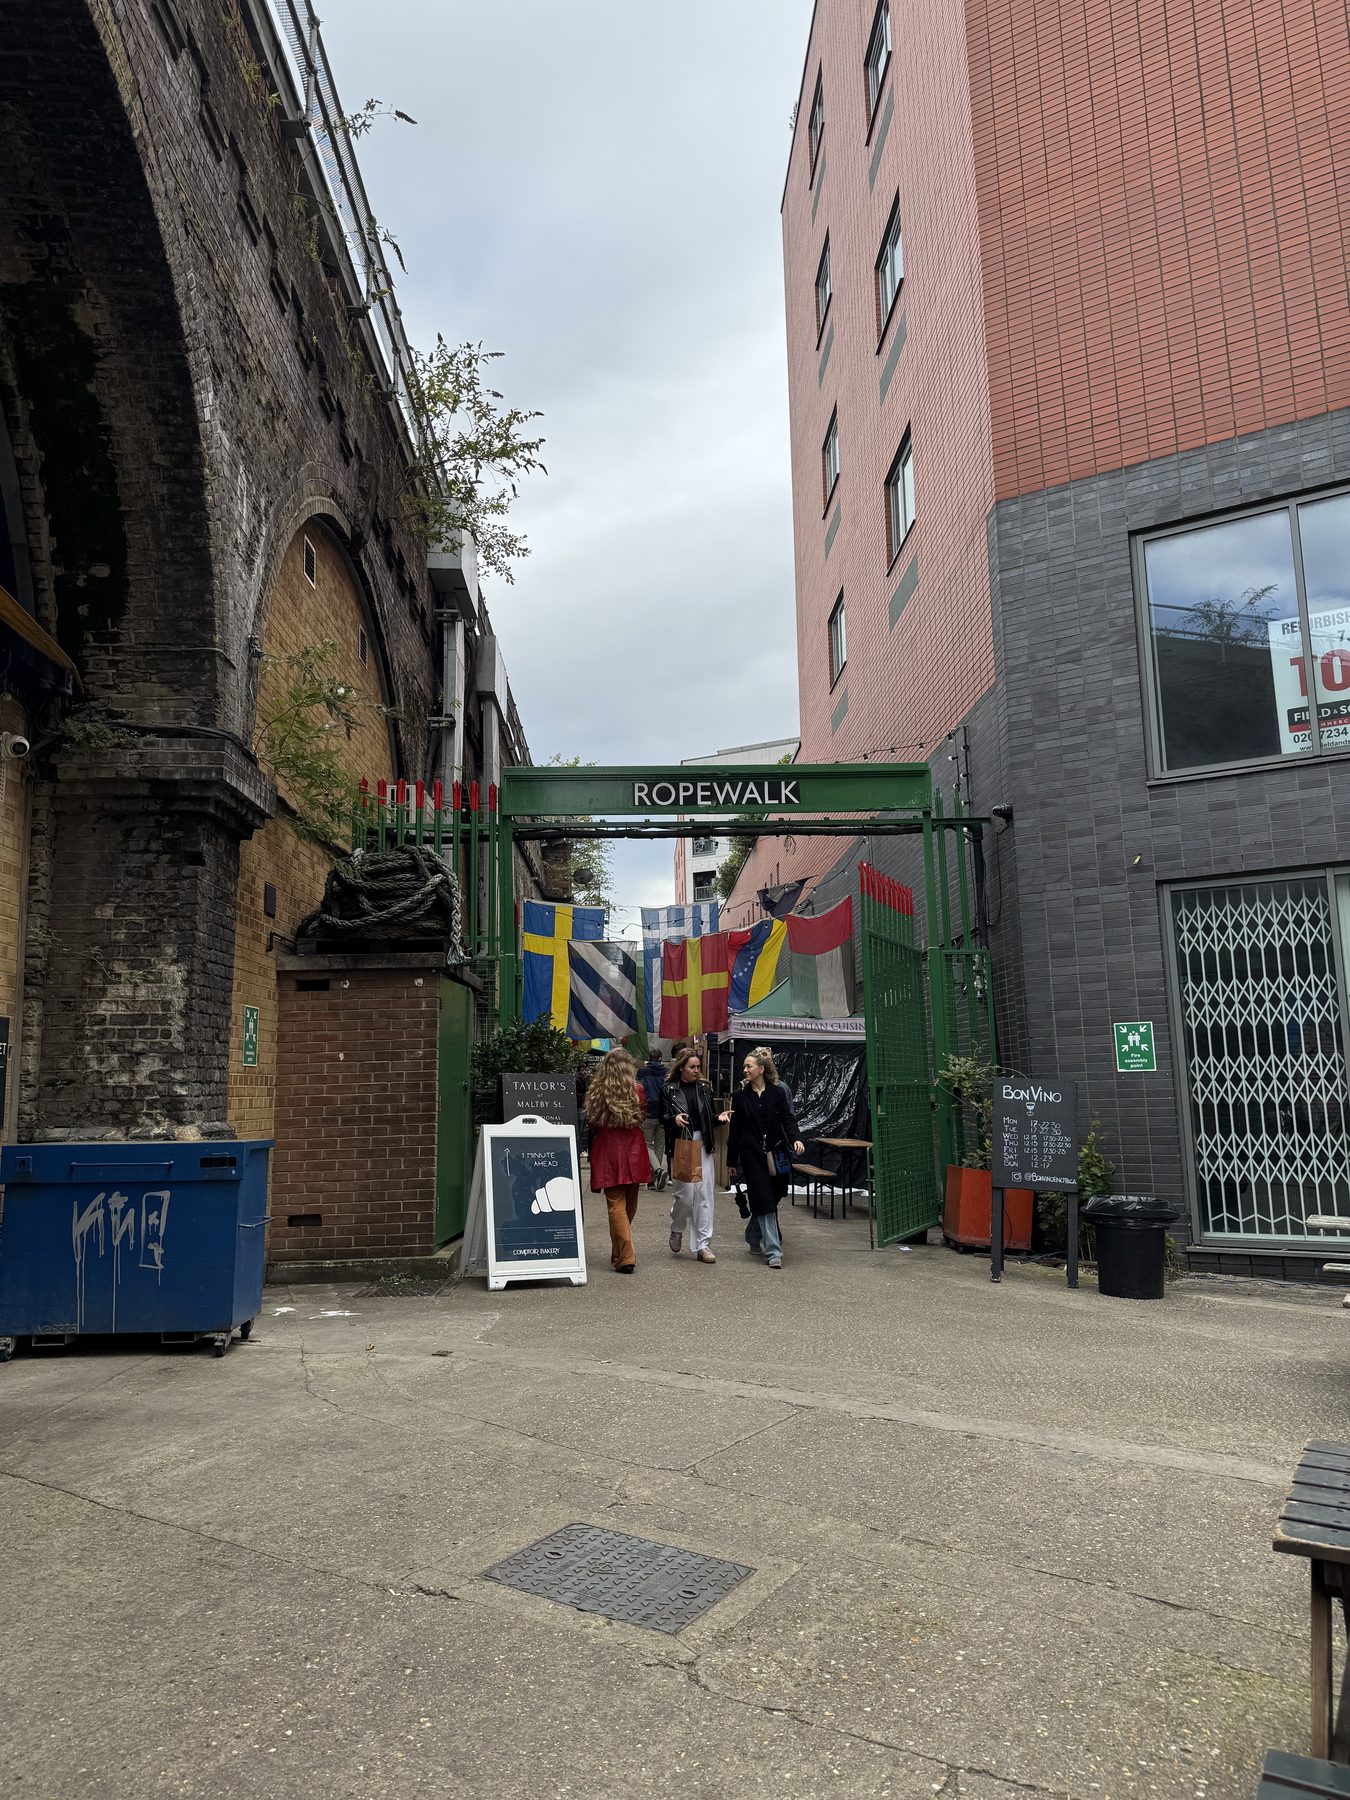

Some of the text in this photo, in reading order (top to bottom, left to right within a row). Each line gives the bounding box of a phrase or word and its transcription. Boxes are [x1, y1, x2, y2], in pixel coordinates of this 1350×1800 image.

[1294, 708, 1331, 722] FIED
[1319, 727, 1348, 739] 7234
[634, 781, 800, 806] ROPEWALK
[740, 1021, 865, 1031] AMEN ETHIOPIAN CUISIN
[512, 1081, 566, 1091] TAYLOR'S
[540, 1247, 560, 1255] BAKERY
